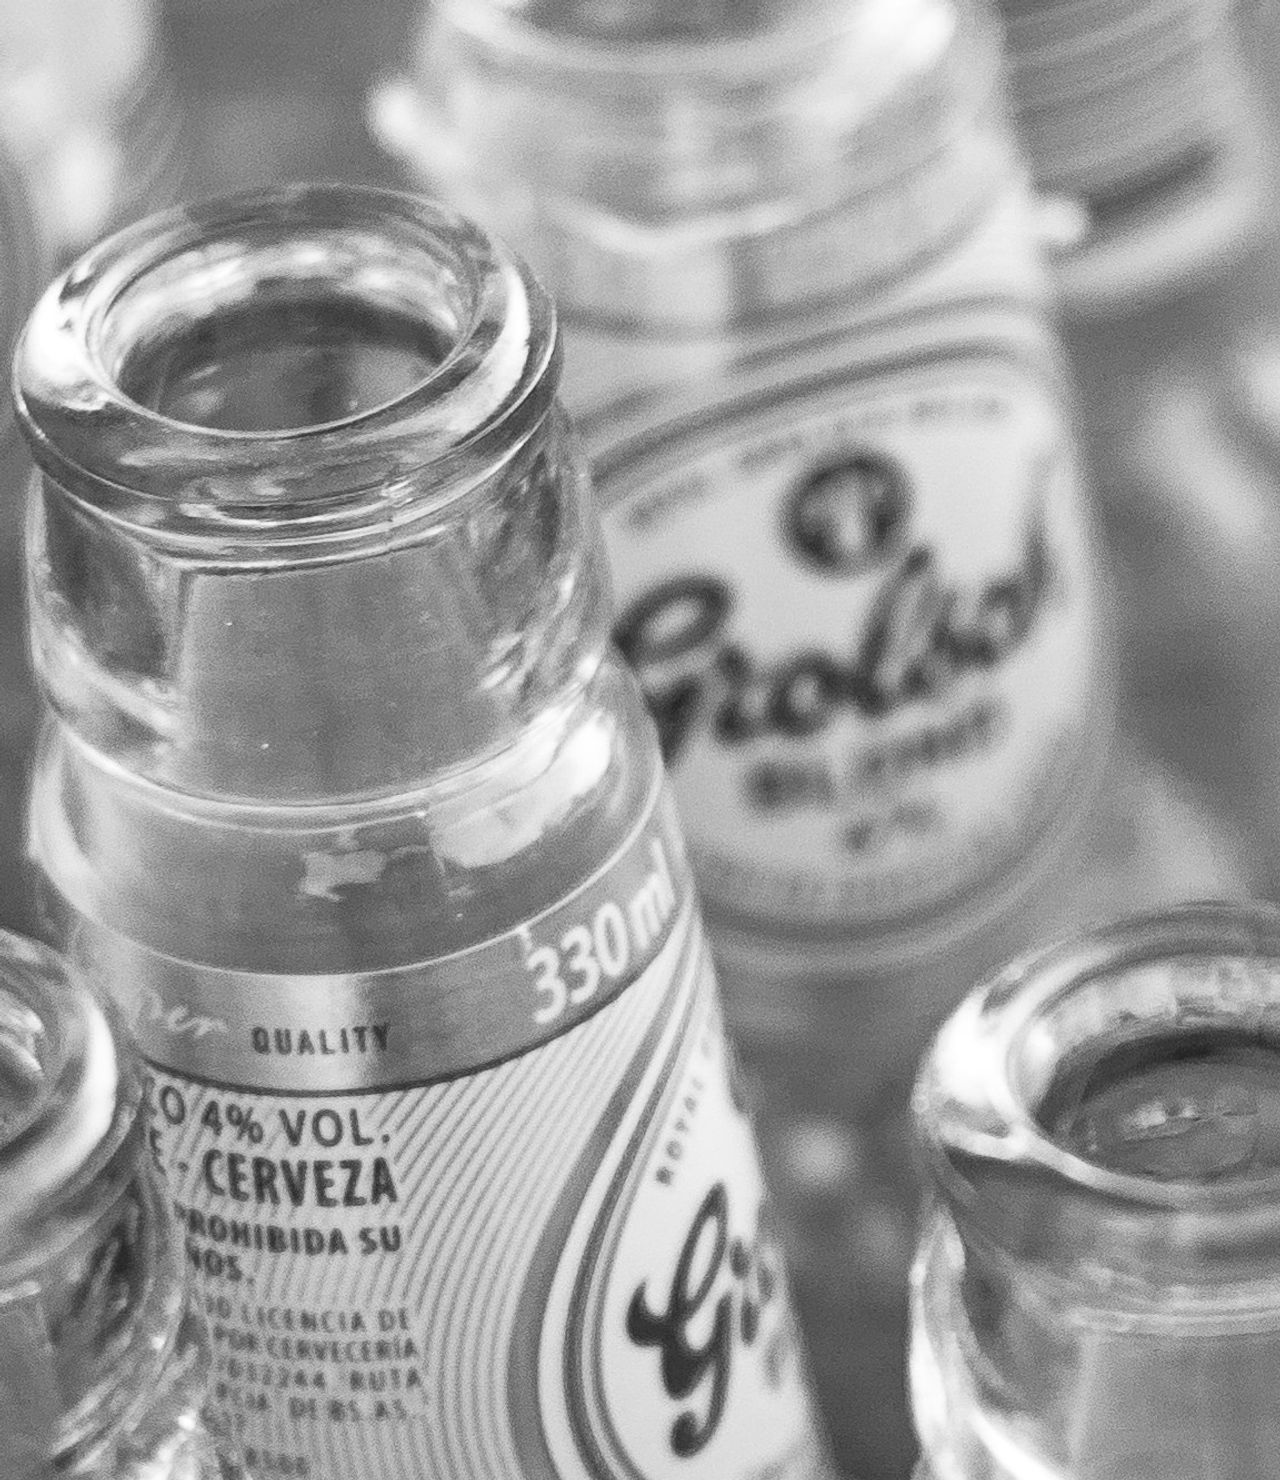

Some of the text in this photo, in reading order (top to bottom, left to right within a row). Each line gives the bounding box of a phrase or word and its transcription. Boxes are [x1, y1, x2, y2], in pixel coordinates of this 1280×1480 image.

[251, 1023, 391, 1055] QUALITY
[279, 1108, 391, 1148] VOL.
[203, 1149, 398, 1208] CERVEZA
[358, 1225, 401, 1255] SU
